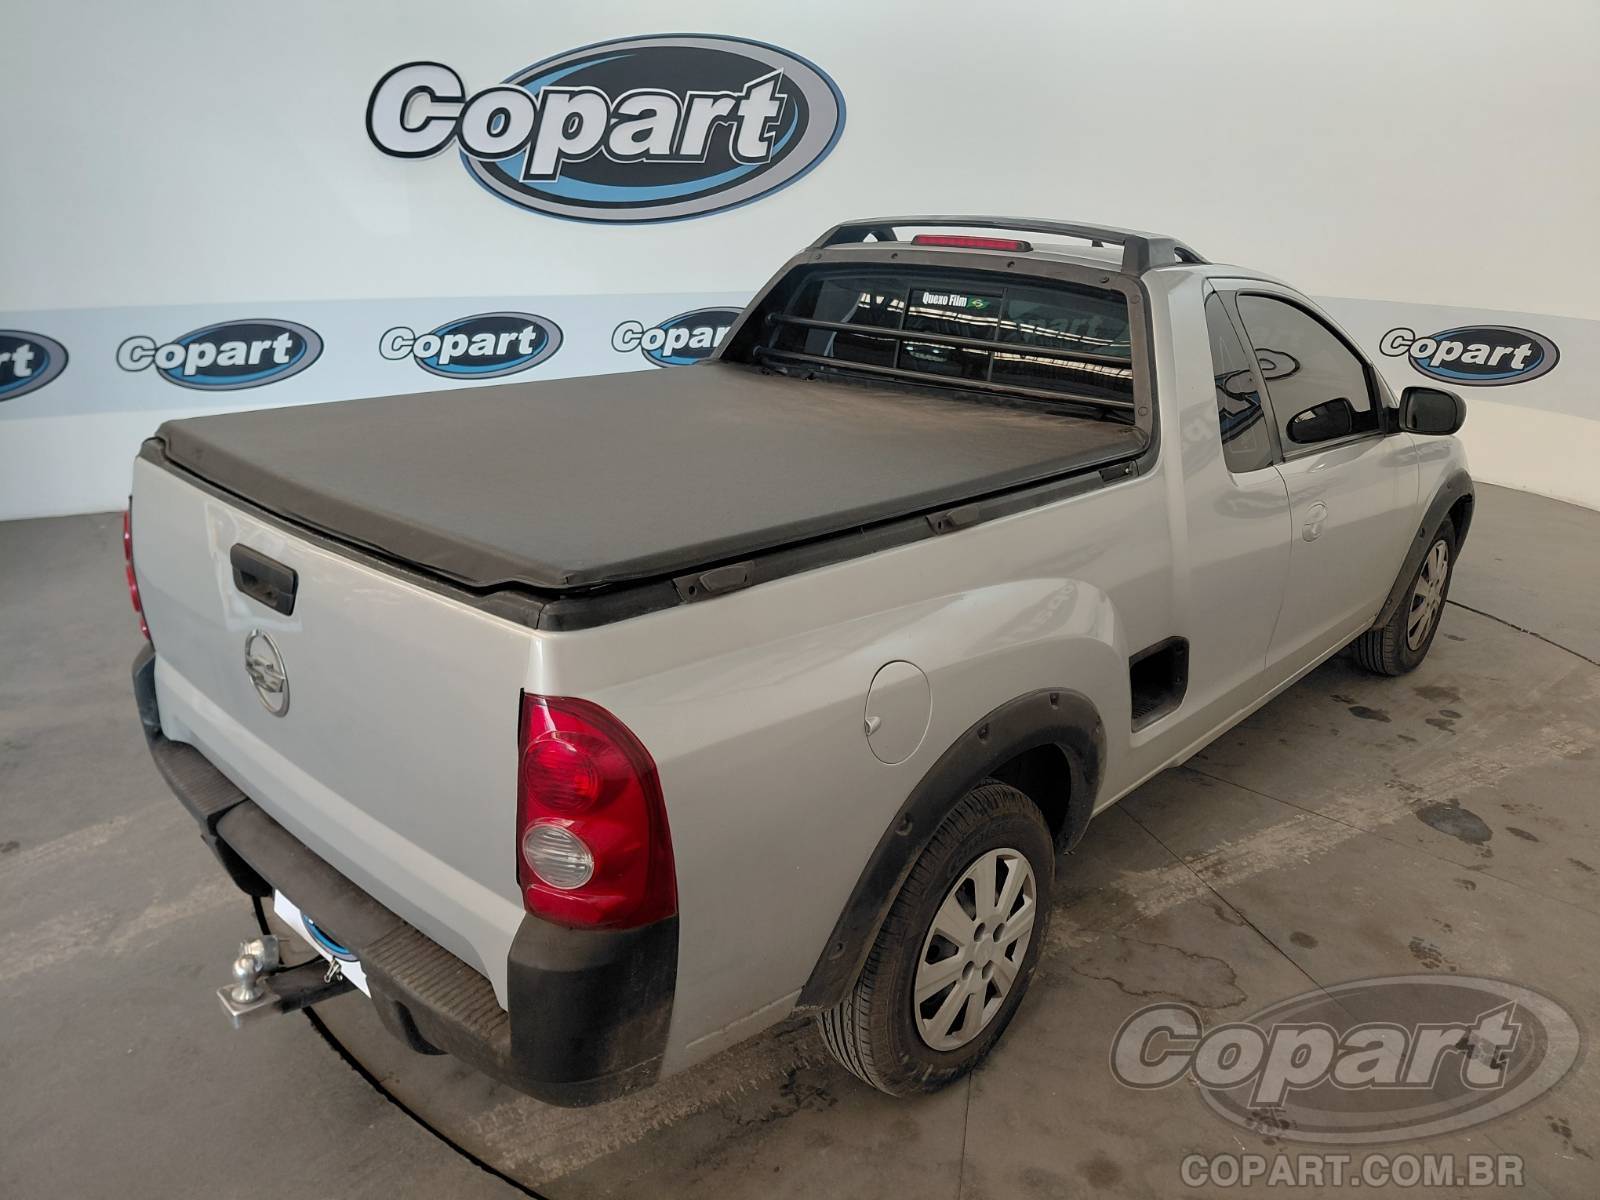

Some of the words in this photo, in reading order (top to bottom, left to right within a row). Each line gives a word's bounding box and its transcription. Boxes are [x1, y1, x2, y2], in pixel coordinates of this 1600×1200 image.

[366, 61, 787, 182] Copart
[949, 294, 968, 307] Film
[116, 332, 294, 376] Copart
[379, 325, 537, 365] Copart
[611, 320, 732, 357] Copar
[1379, 327, 1533, 371] Copart
